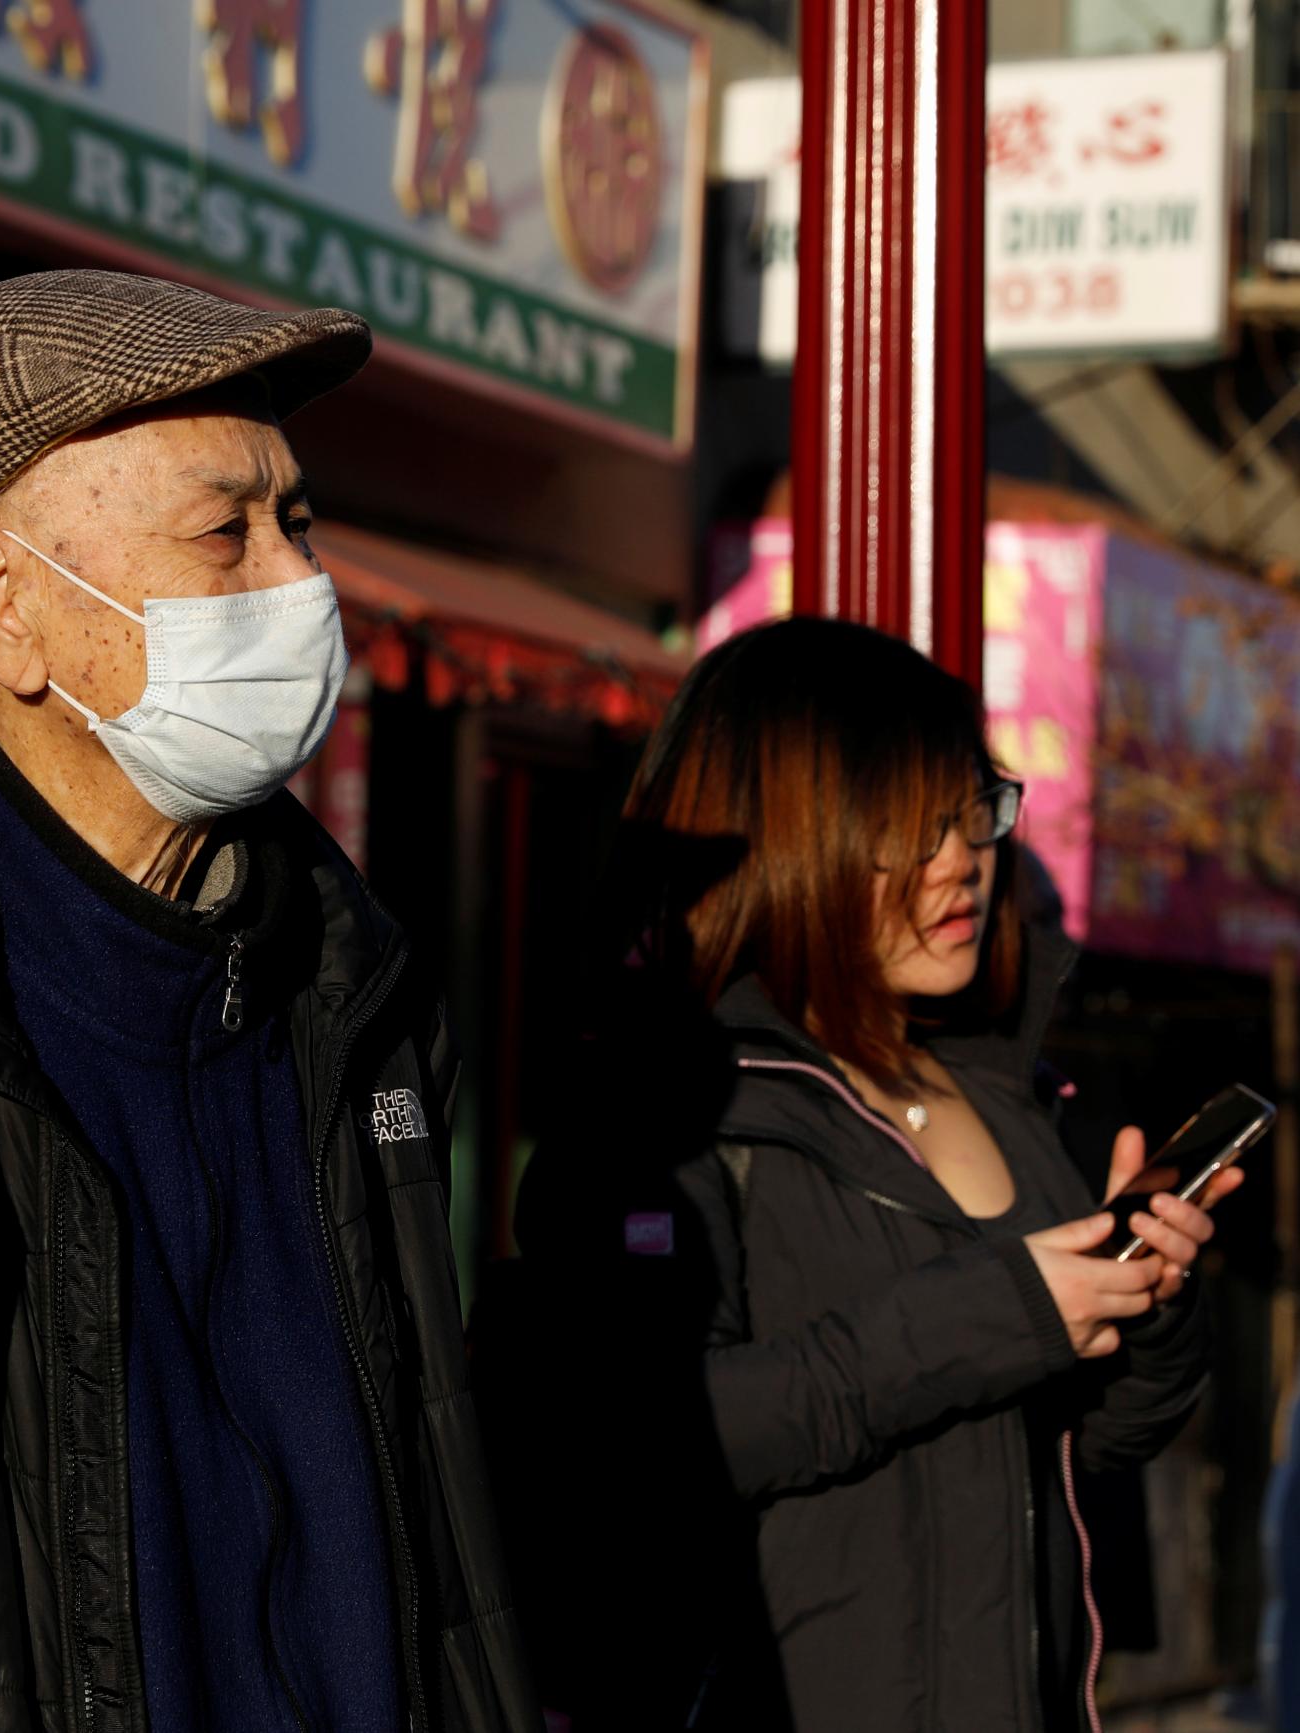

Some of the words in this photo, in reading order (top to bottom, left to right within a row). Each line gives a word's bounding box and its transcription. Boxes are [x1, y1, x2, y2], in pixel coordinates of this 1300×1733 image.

[70, 128, 635, 404] RESTAURANT
[372, 1089, 408, 1110] THE
[357, 1104, 409, 1128] ORTH
[368, 1121, 416, 1145] FACE
